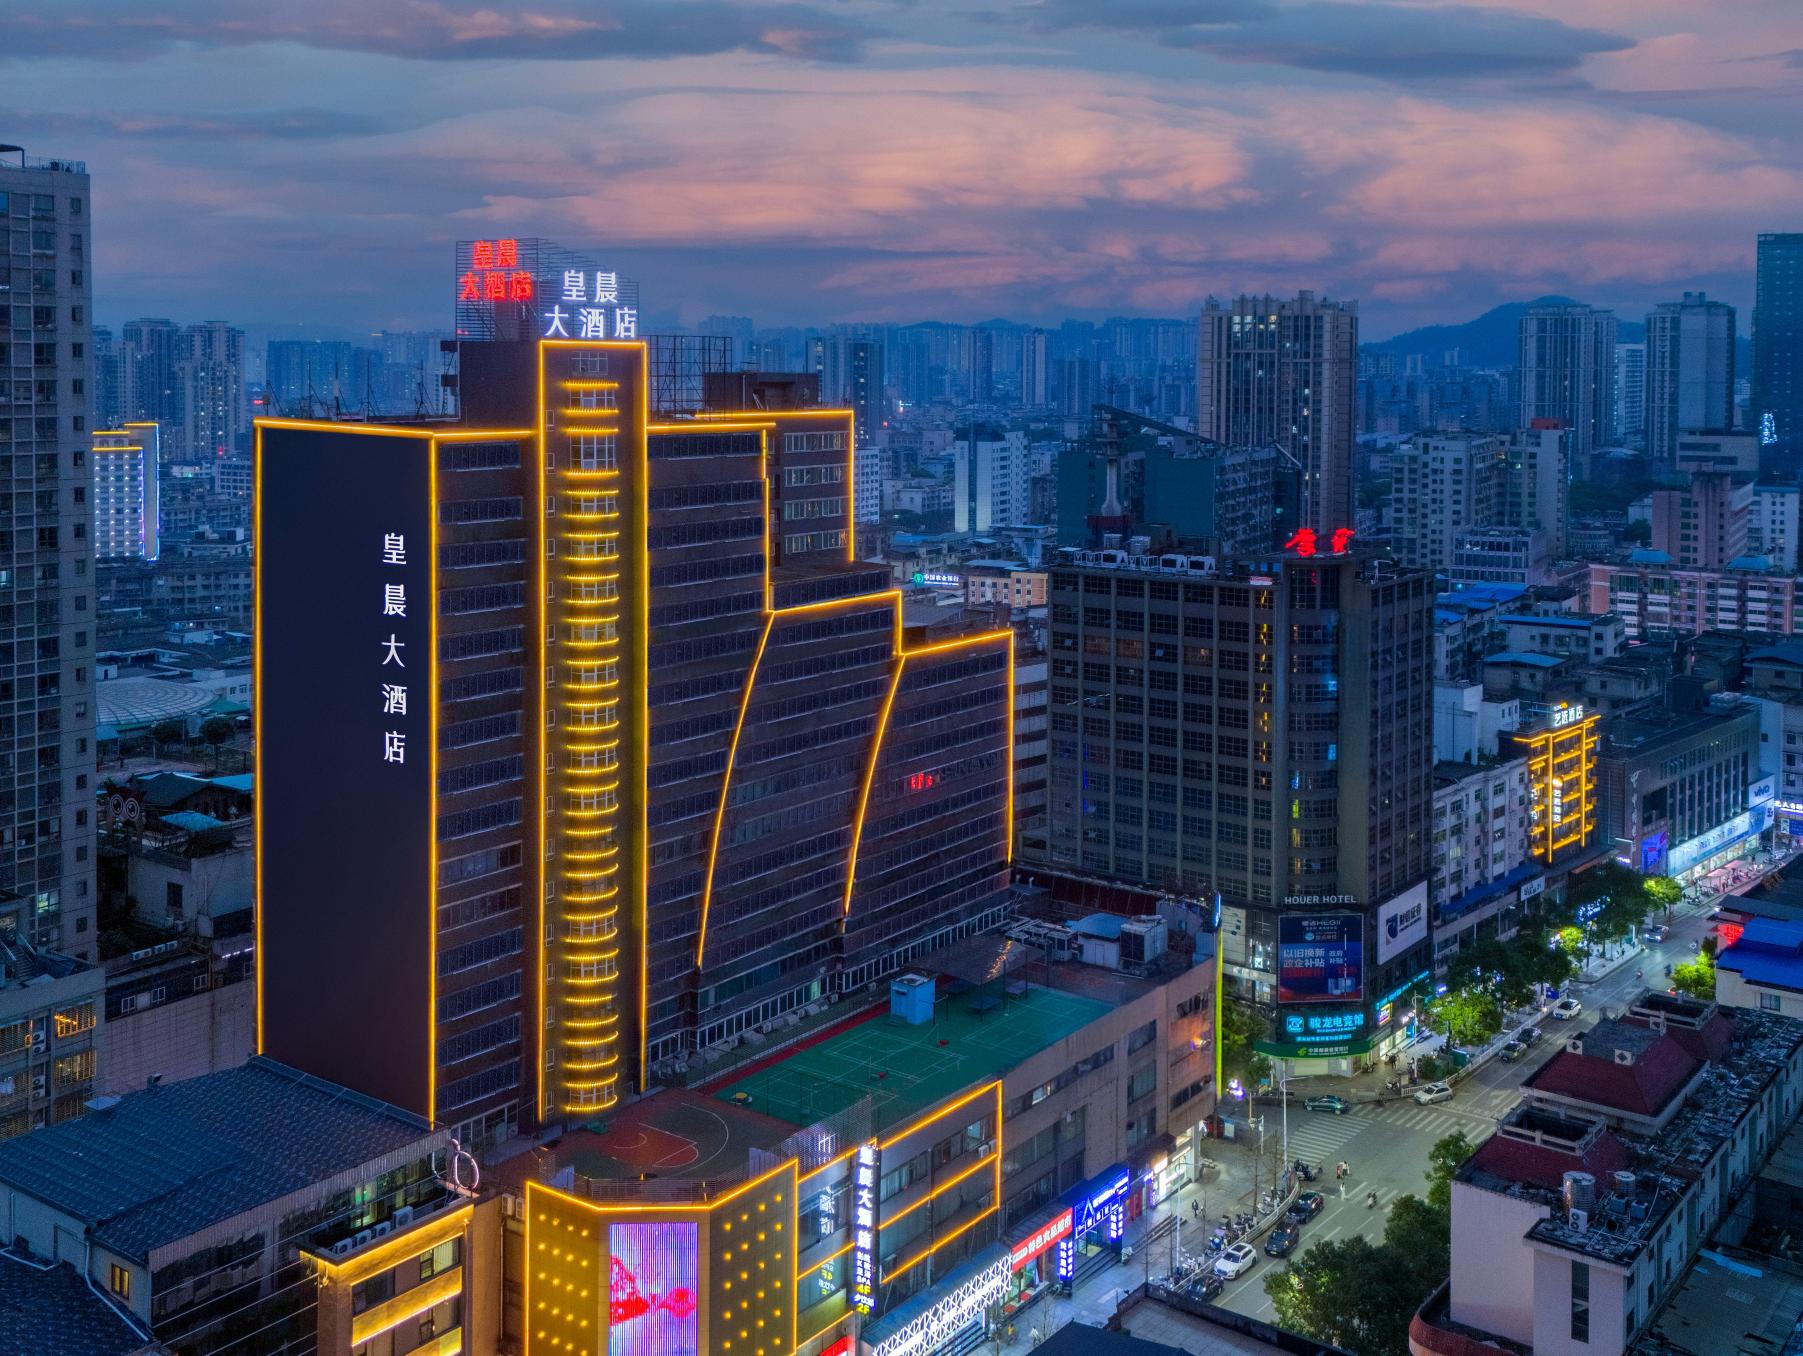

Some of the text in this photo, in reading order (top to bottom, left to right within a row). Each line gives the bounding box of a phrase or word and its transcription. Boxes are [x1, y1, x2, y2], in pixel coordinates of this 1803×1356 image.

[473, 239, 517, 268] 皇晨
[459, 271, 532, 300] 大酒店
[562, 270, 618, 303] 皇晨
[544, 305, 637, 338] 大酒店
[382, 532, 408, 764] 皇晨大酒店
[1285, 895, 1357, 904] HOUER HOTEL
[1283, 948, 1325, 958] 以旧换新
